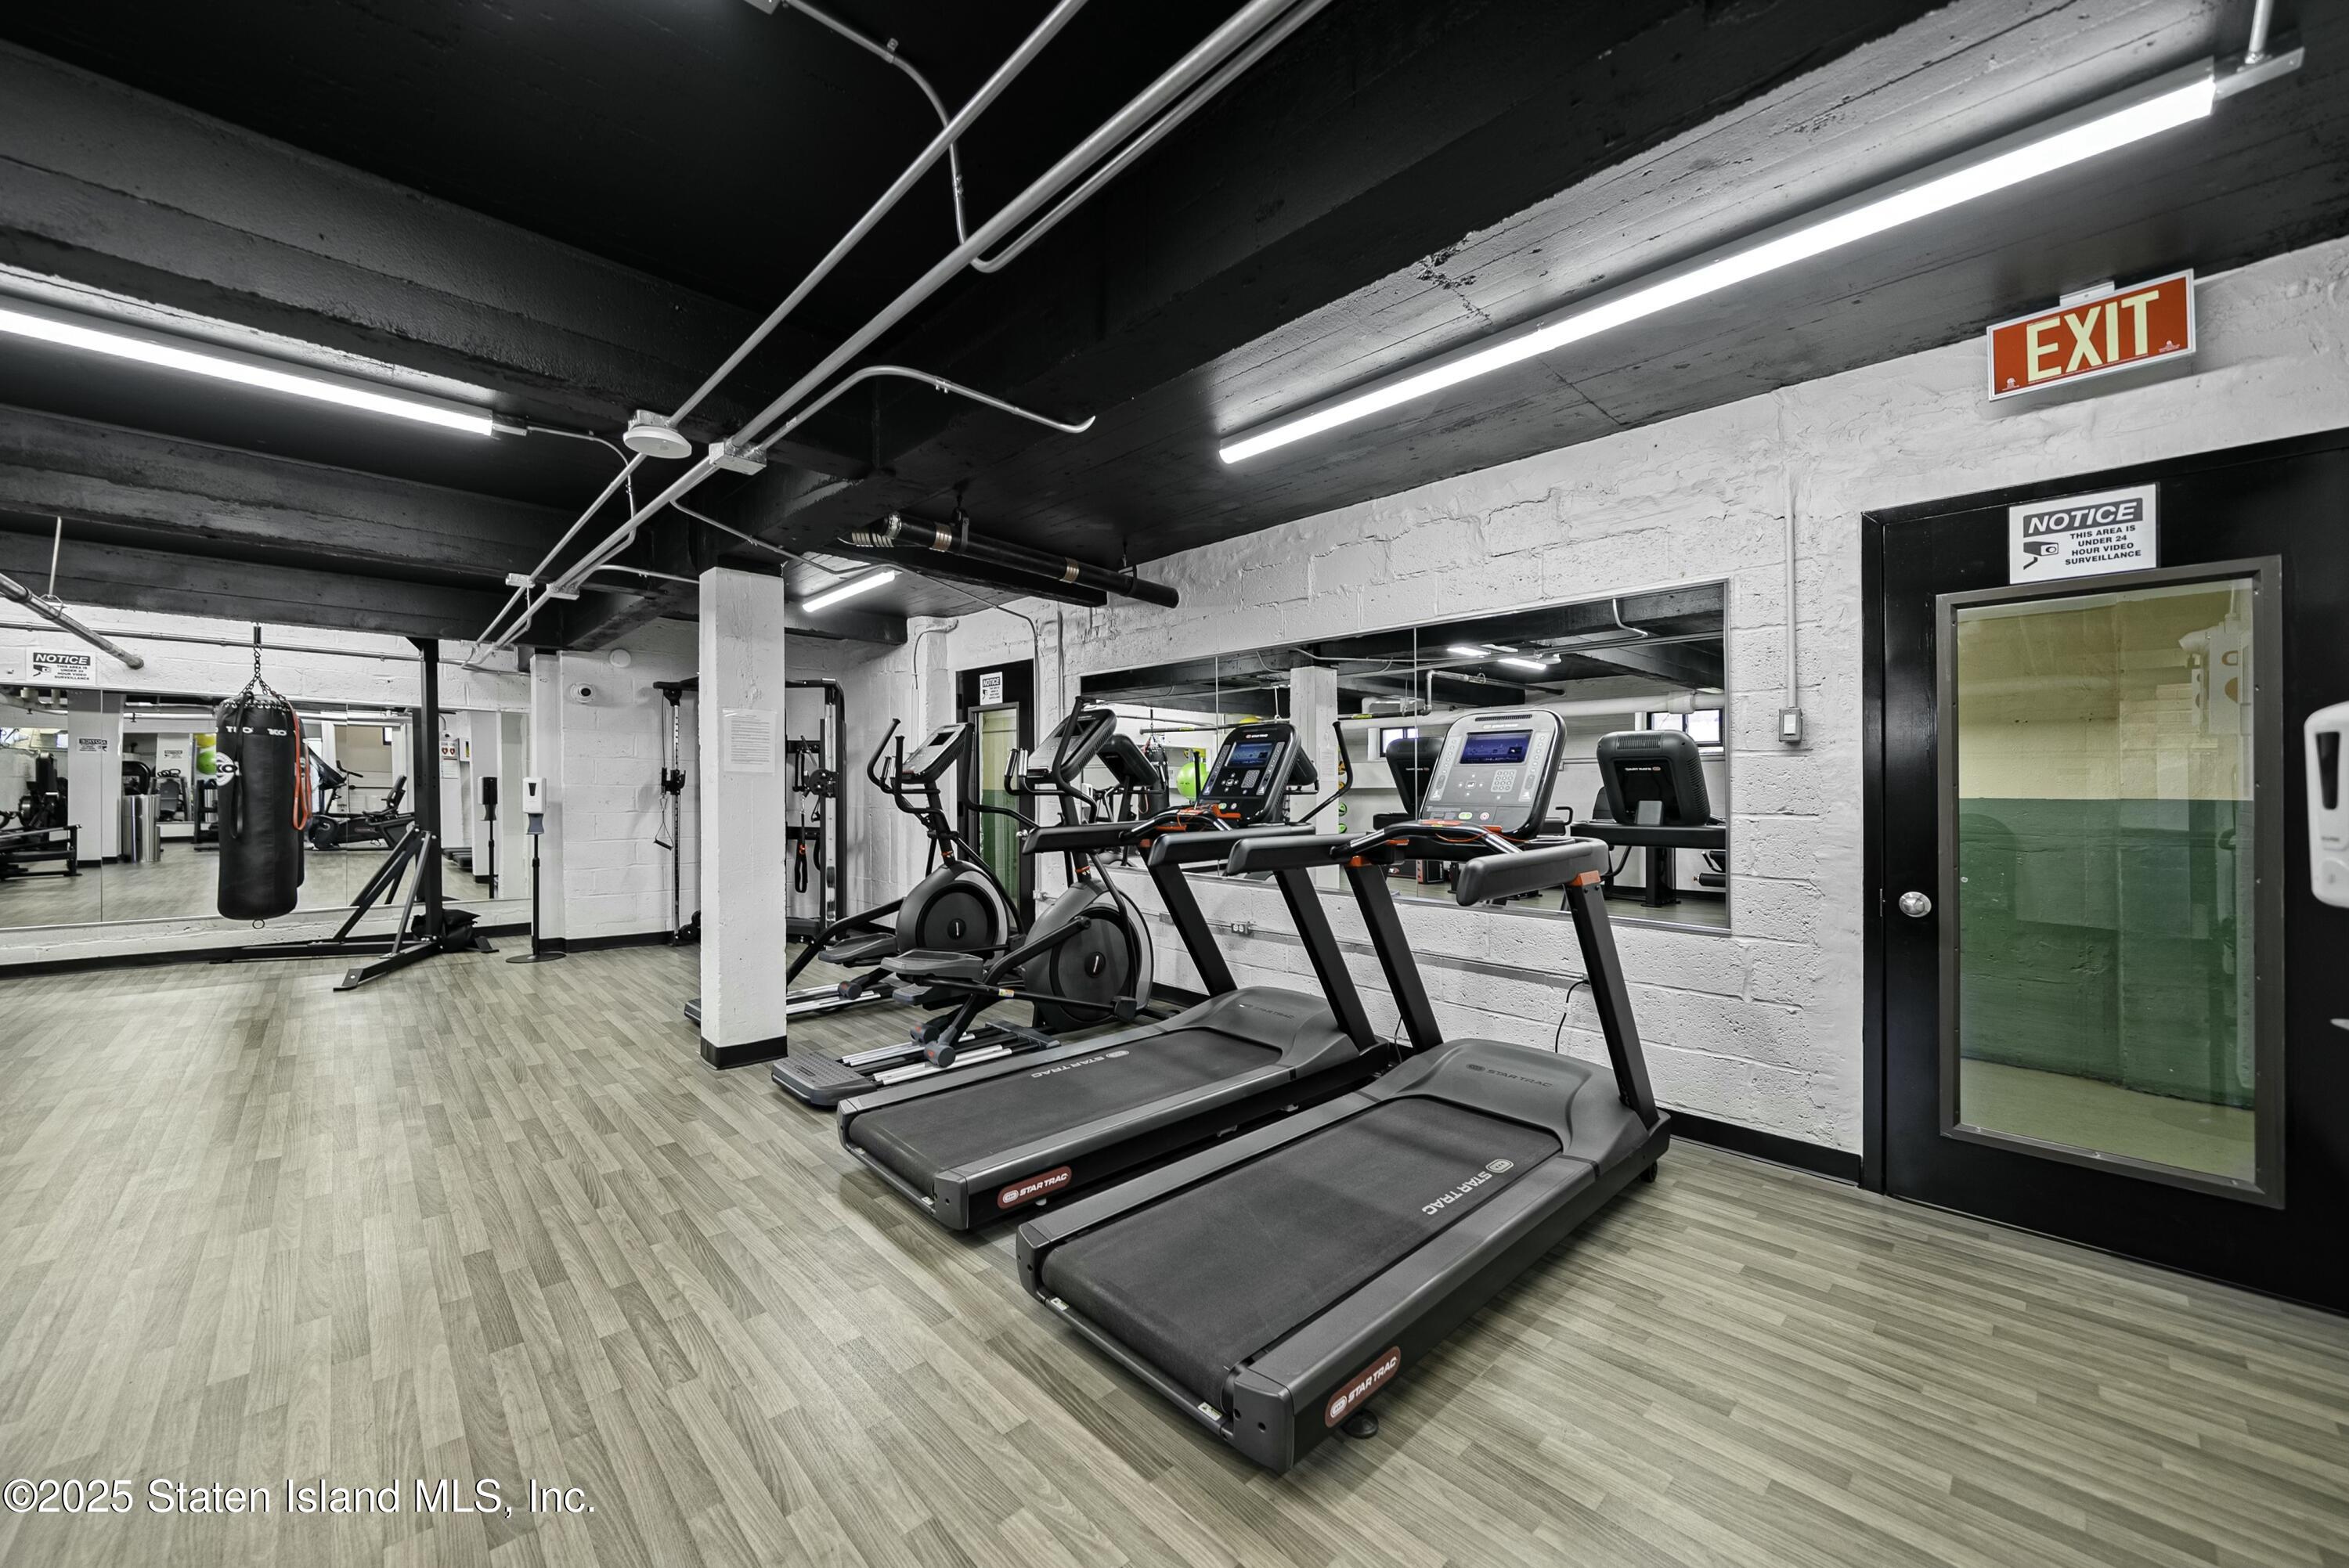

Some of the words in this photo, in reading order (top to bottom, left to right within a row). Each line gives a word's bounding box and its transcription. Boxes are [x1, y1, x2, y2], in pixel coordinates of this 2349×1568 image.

[2026, 290, 2160, 383] EXIT
[2028, 502, 2138, 534] NOTICE
[2069, 531, 2093, 539] THIS
[2096, 527, 2123, 536] AREA
[2072, 546, 2100, 556] HOUR
[2103, 542, 2134, 552] VIDEO
[2078, 536, 2113, 547] UNDER
[2065, 550, 2142, 565] SURVEILLANCE
[35, 654, 88, 665] NOTICE
[983, 677, 1000, 687] NOTICE
[1070, 1056, 1105, 1068] STAR
[1030, 1065, 1071, 1078] TRAC
[1487, 1069, 1518, 1079] STAR
[1520, 1076, 1553, 1087] TRAC
[1019, 1181, 1044, 1196] STAR
[1044, 1173, 1069, 1187] TRAC
[1456, 1171, 1492, 1193] STAR
[1421, 1191, 1463, 1215] TRAC
[1348, 1375, 1373, 1403] STAR
[1373, 1356, 1398, 1382] TRAC
